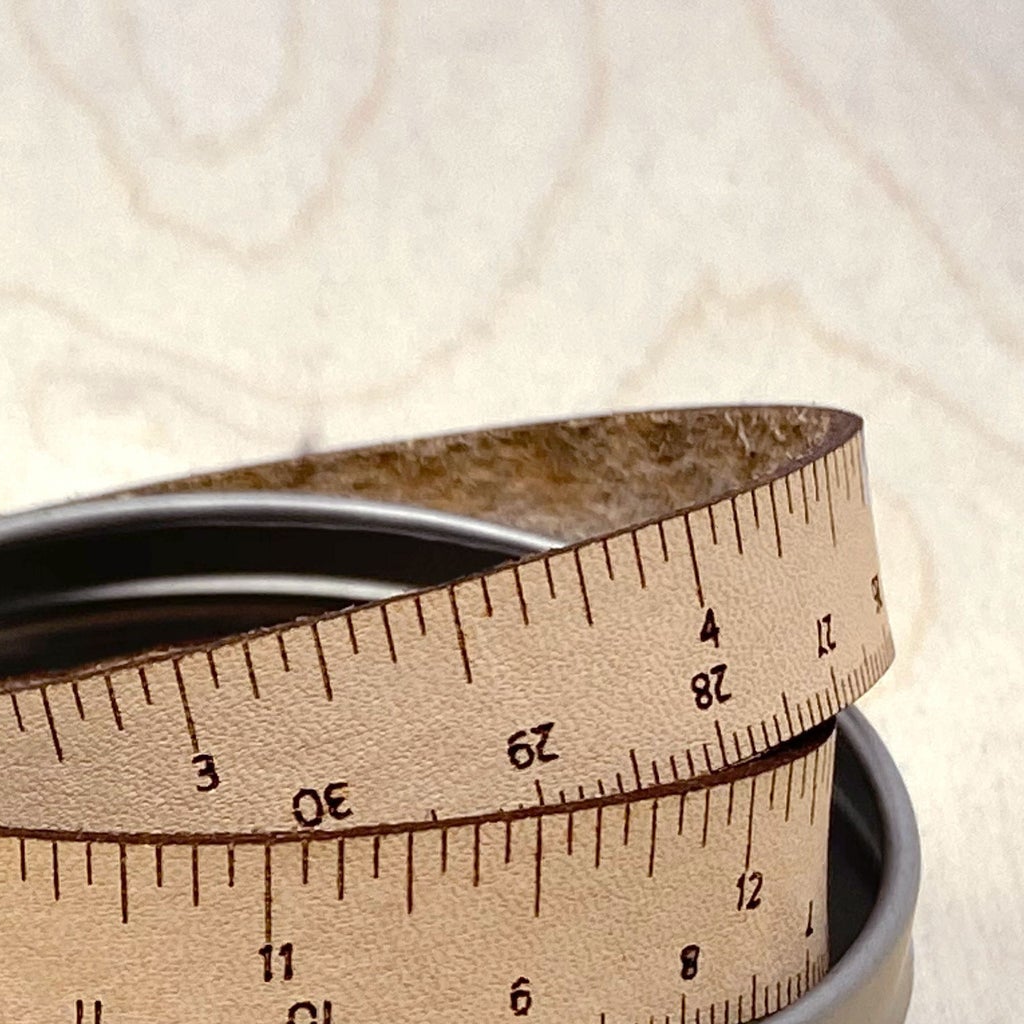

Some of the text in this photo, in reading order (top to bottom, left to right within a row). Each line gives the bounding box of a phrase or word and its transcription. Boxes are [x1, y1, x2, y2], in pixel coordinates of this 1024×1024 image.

[699, 607, 721, 649] 4
[690, 663, 733, 711] 28
[506, 721, 560, 771] 29
[191, 753, 222, 793] 3
[292, 782, 354, 828] 30
[735, 871, 764, 912] 12
[258, 942, 294, 983] 11
[679, 943, 701, 981] 8
